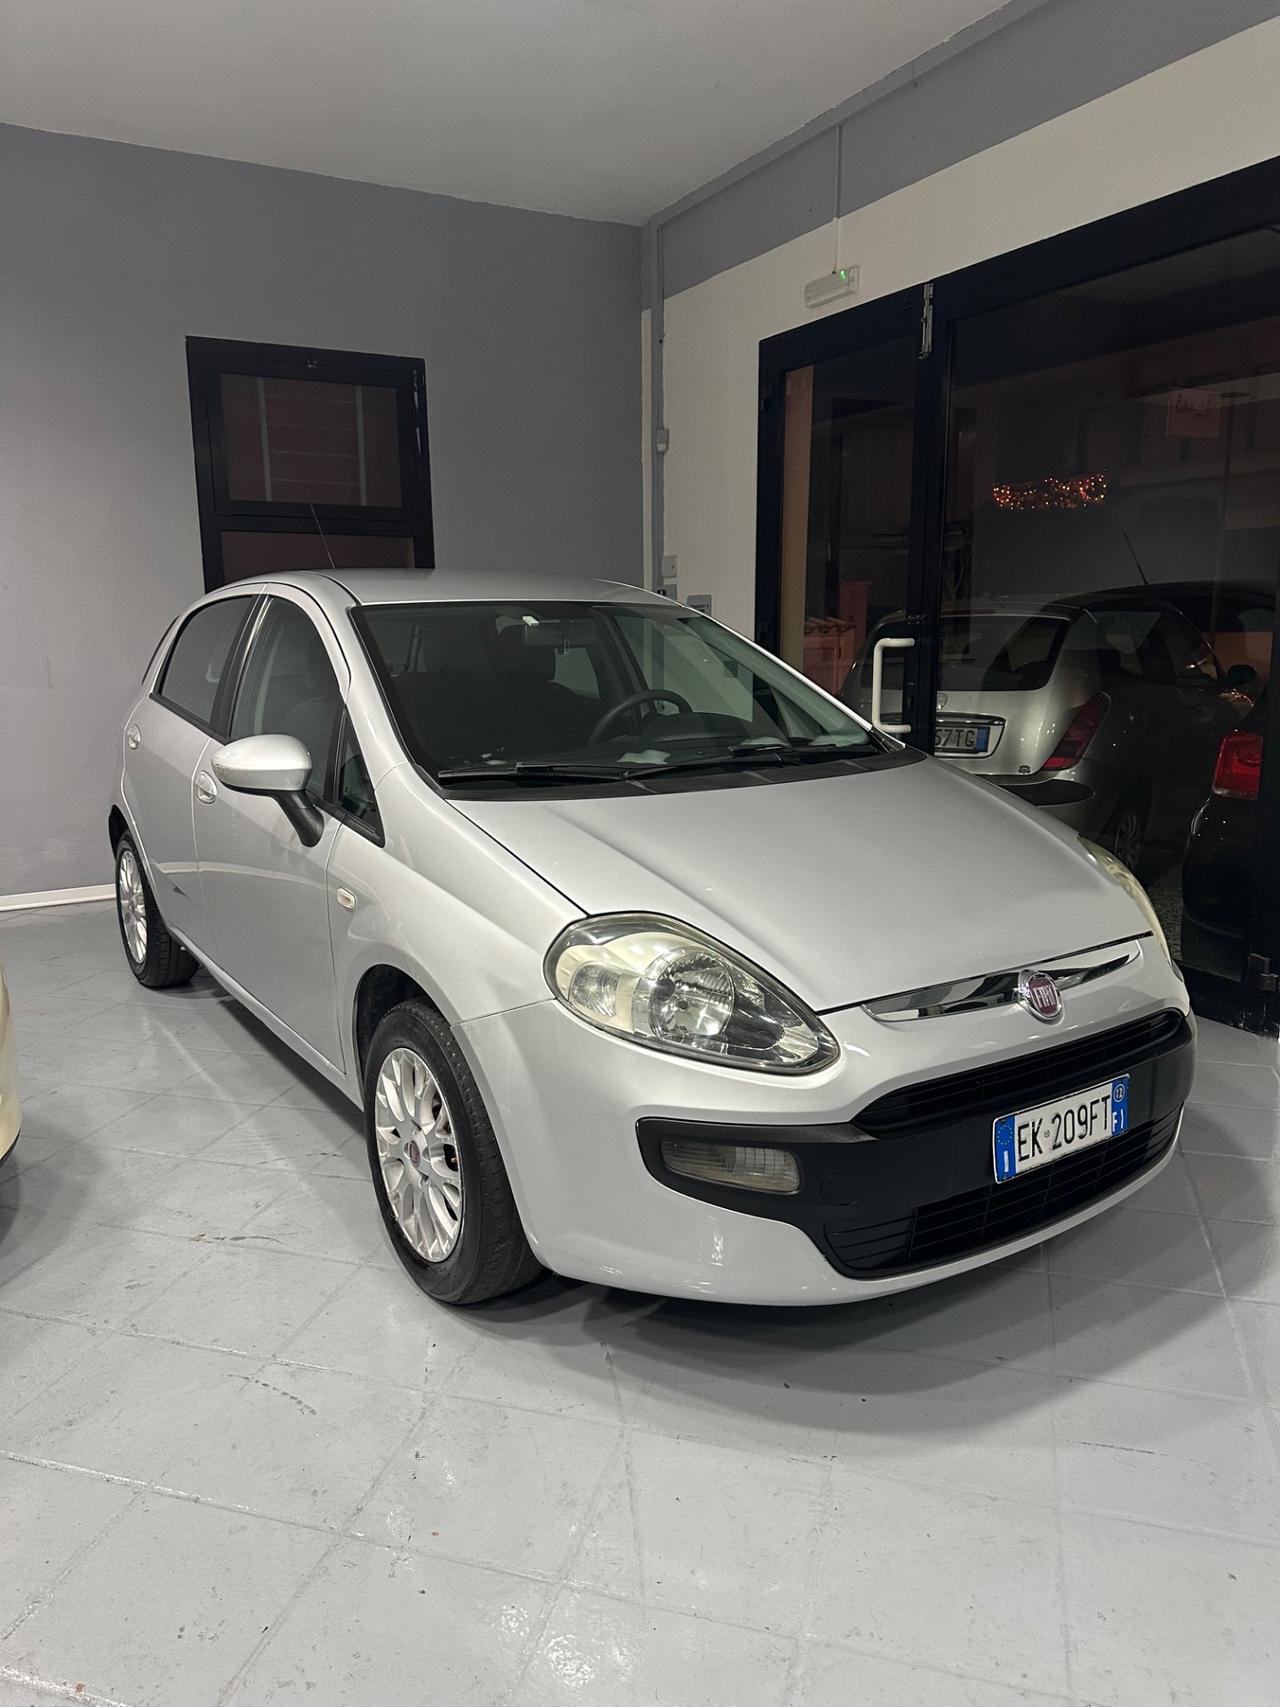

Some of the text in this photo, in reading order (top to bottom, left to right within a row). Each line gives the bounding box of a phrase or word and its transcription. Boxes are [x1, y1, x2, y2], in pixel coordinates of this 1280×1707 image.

[1033, 984, 1056, 1009] FIAT
[1017, 1095, 1111, 1162] EK 209FT
[1112, 1108, 1124, 1133] FI
[1003, 1150, 1009, 1173] I
